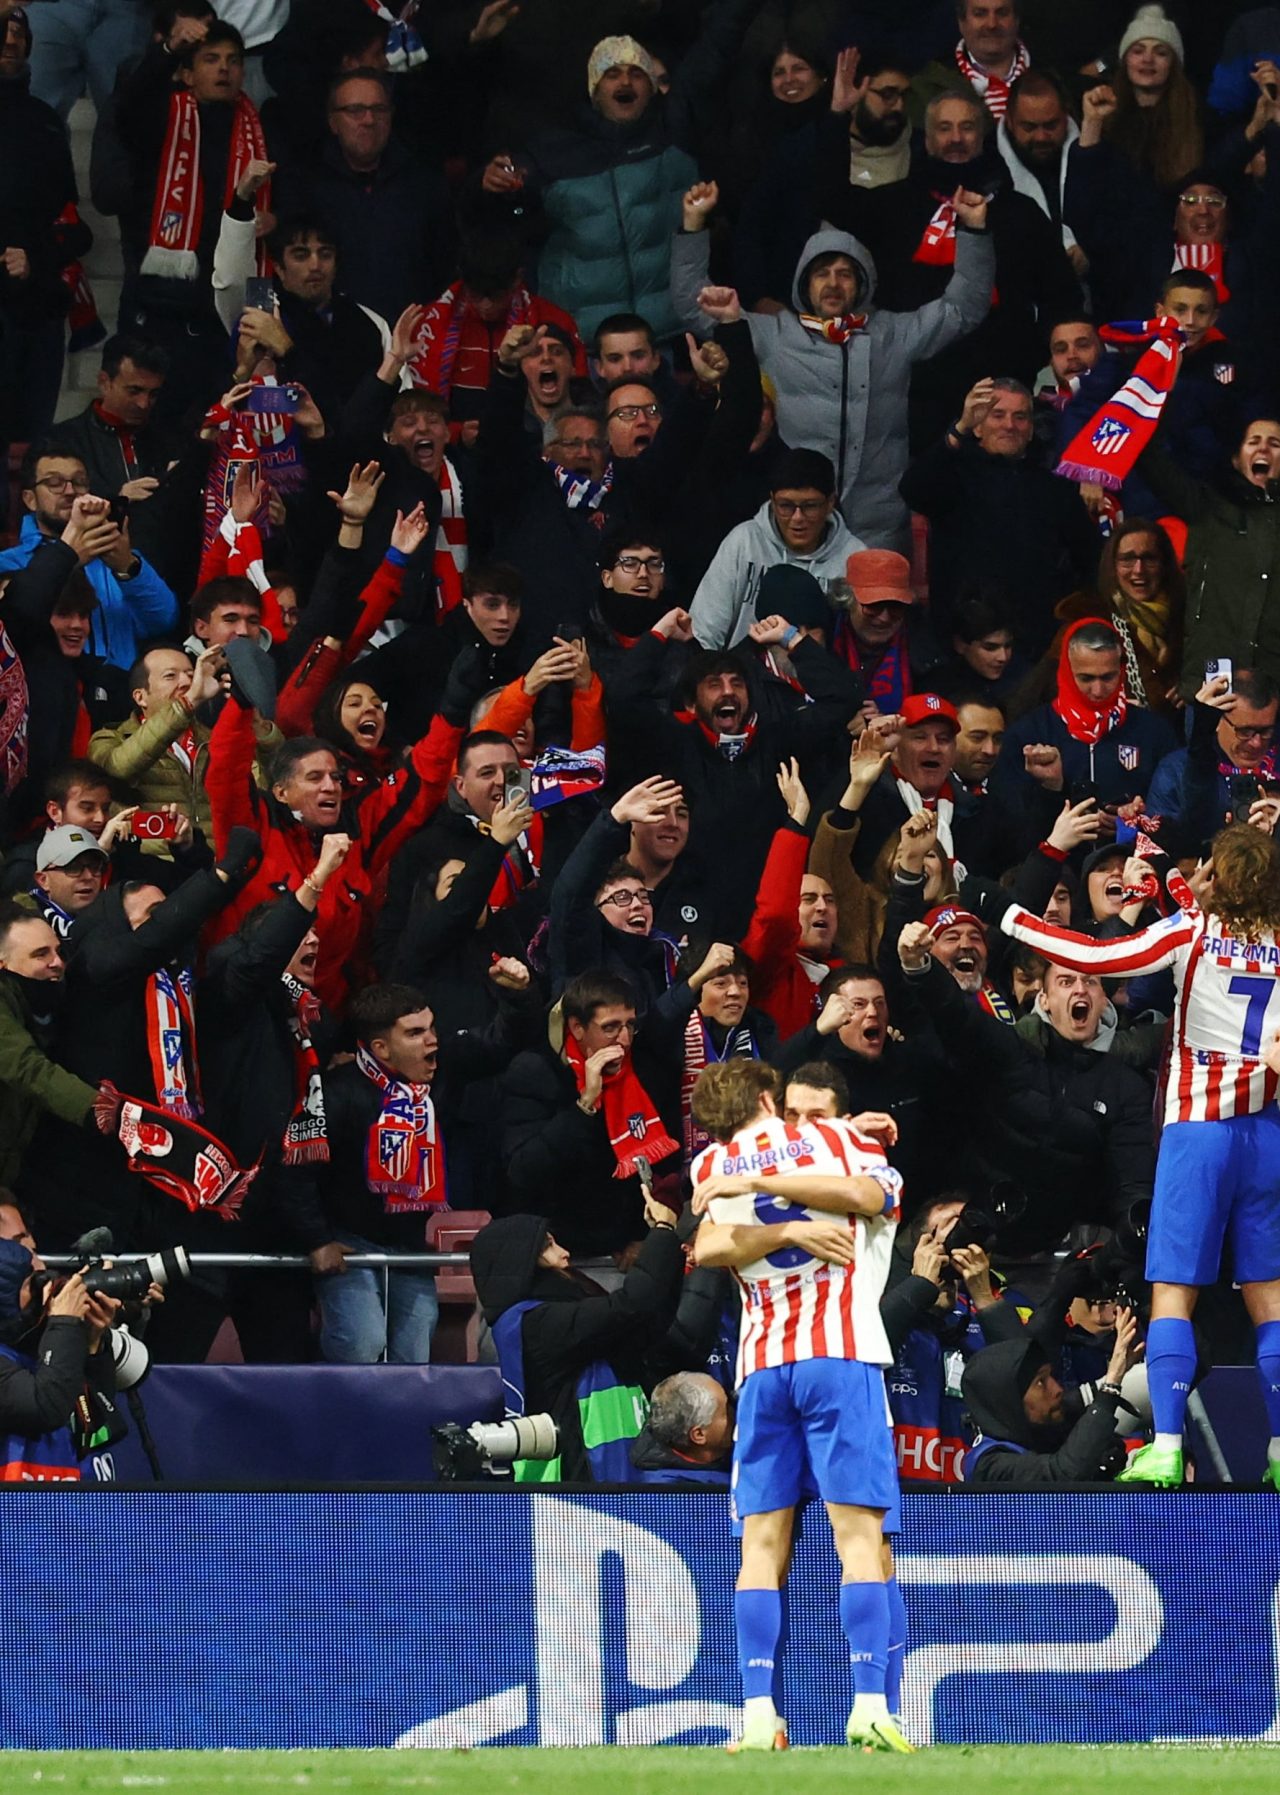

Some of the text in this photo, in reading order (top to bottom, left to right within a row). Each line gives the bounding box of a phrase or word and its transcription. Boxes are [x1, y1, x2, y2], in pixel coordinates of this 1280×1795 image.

[1228, 976, 1277, 1056] 7
[291, 1116, 327, 1133] DIEGO
[723, 1138, 817, 1176] BARRIOS
